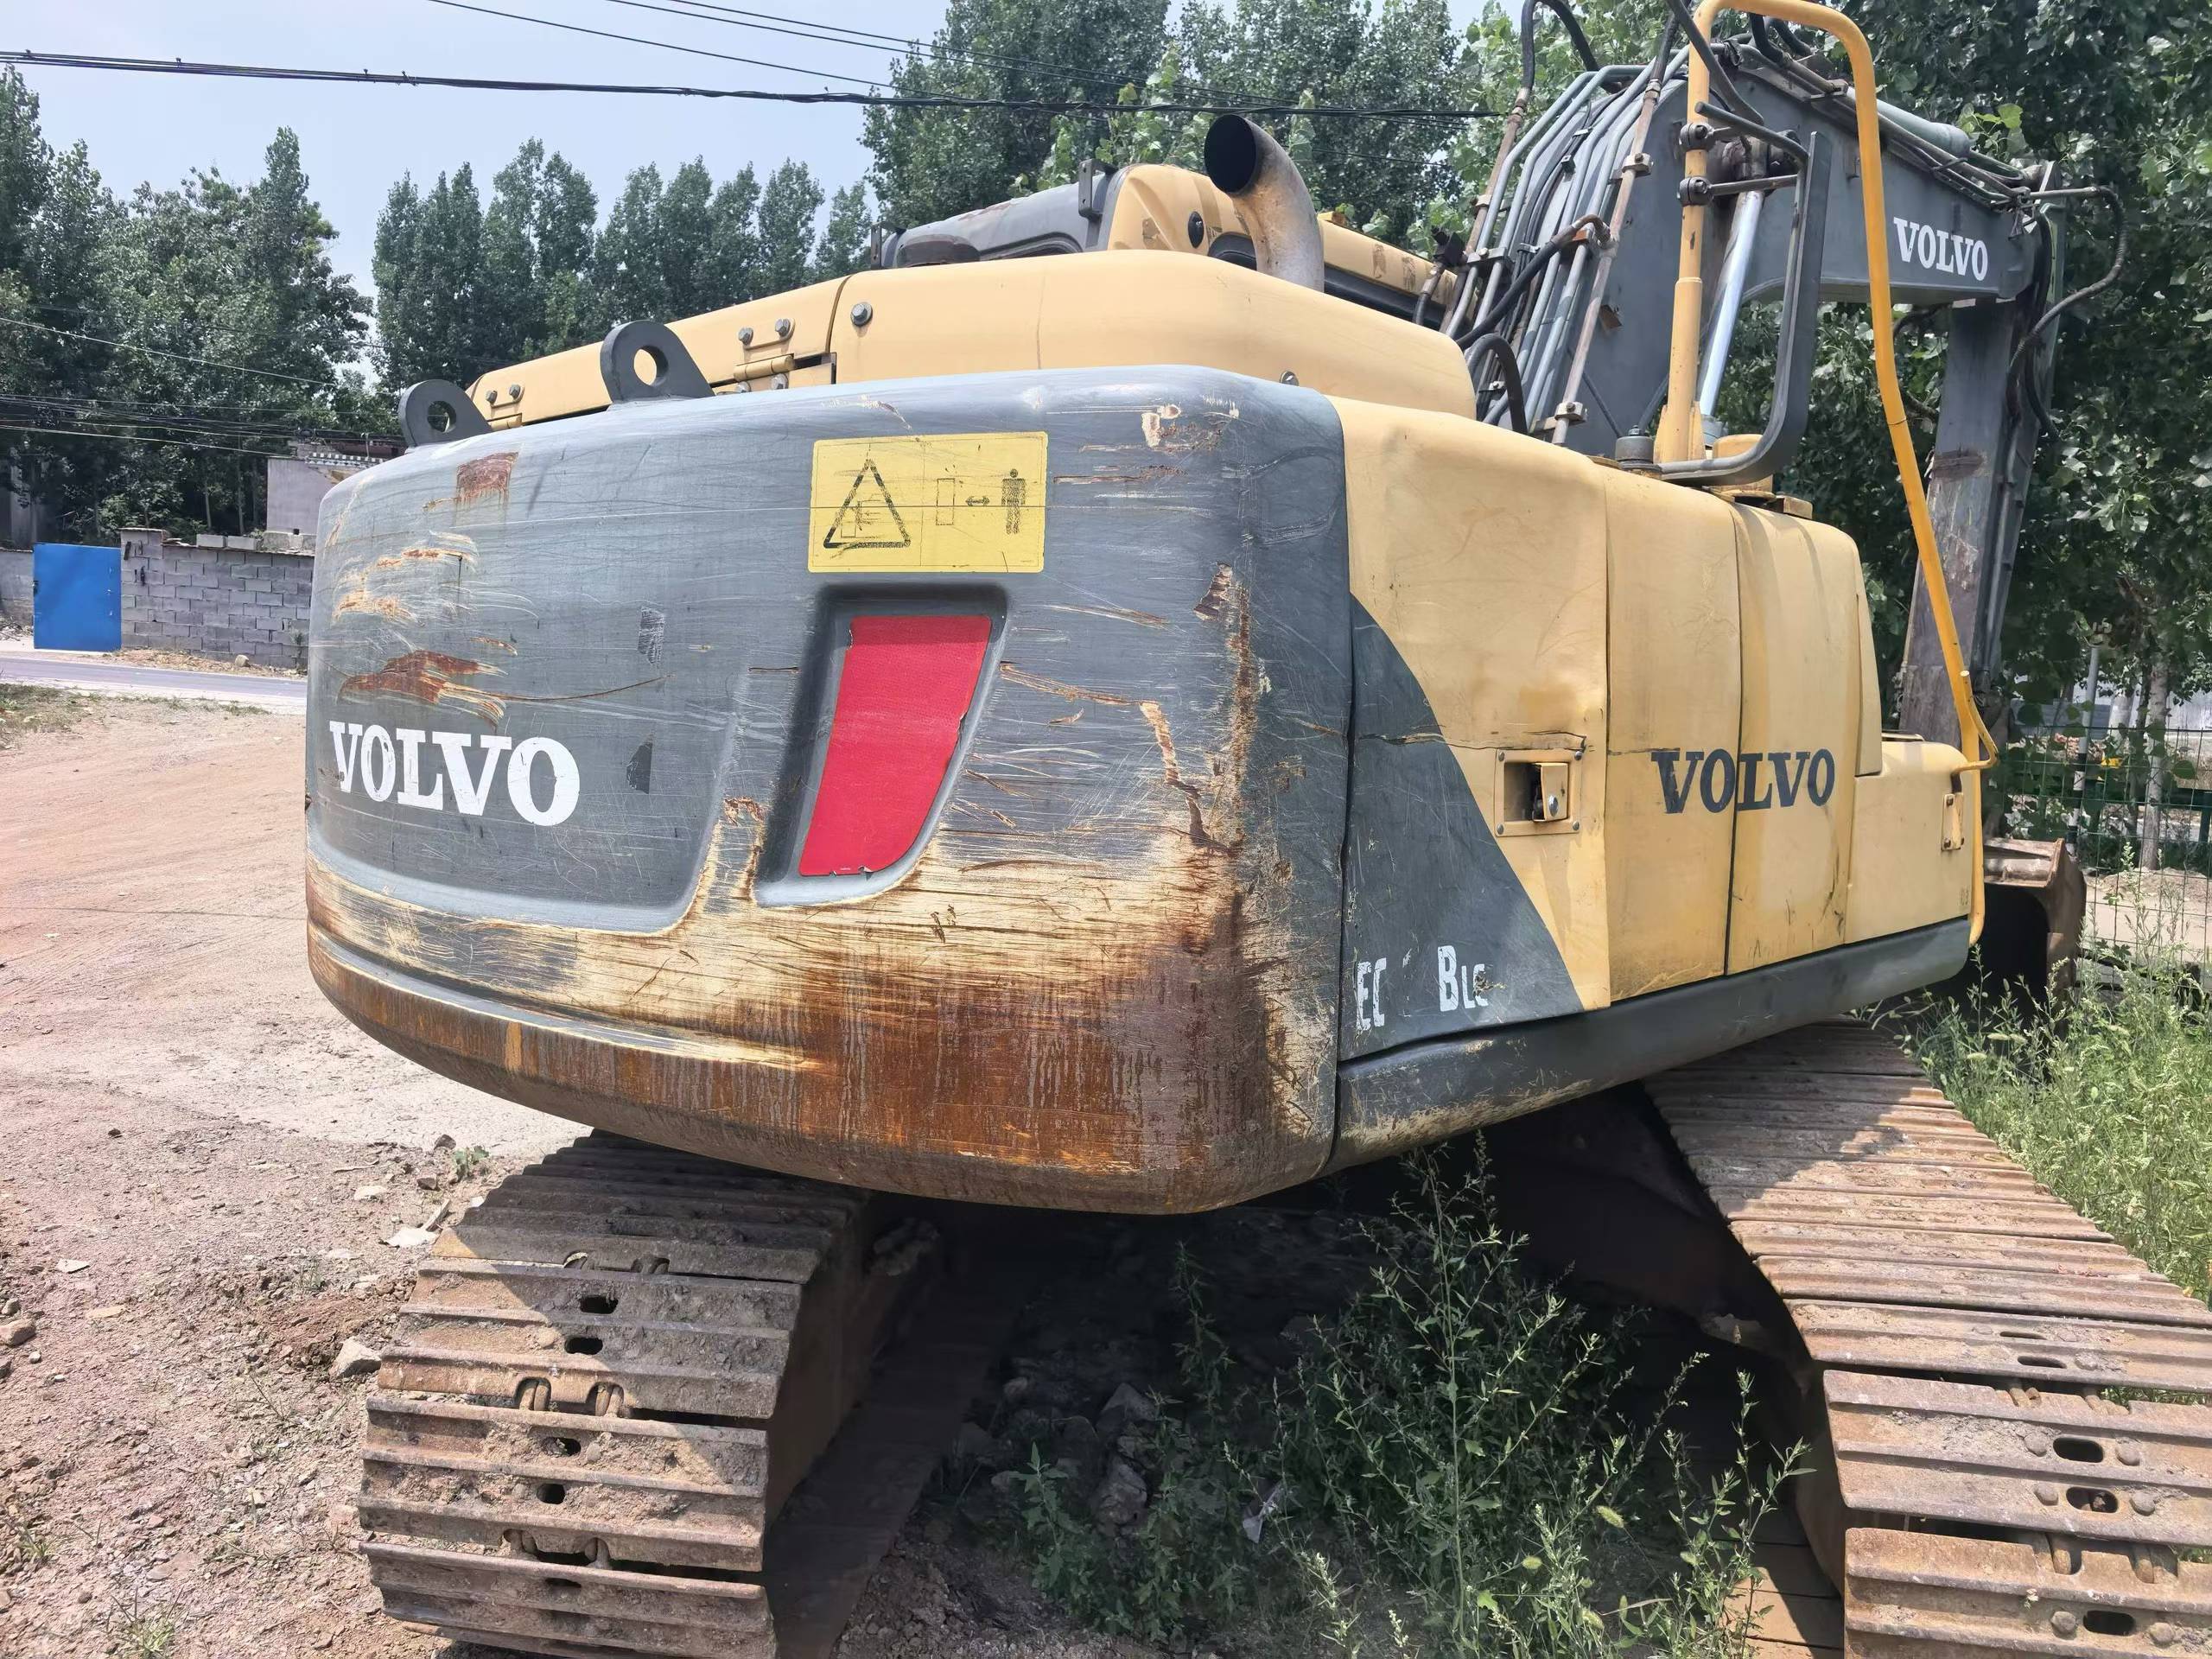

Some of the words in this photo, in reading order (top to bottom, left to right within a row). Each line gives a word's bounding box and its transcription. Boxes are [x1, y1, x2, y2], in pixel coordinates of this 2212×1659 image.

[1893, 217, 1988, 281] VOLVO
[329, 720, 580, 826] VOLVO
[1651, 748, 1835, 814] VOLVO
[1356, 957, 1387, 1031] EC
